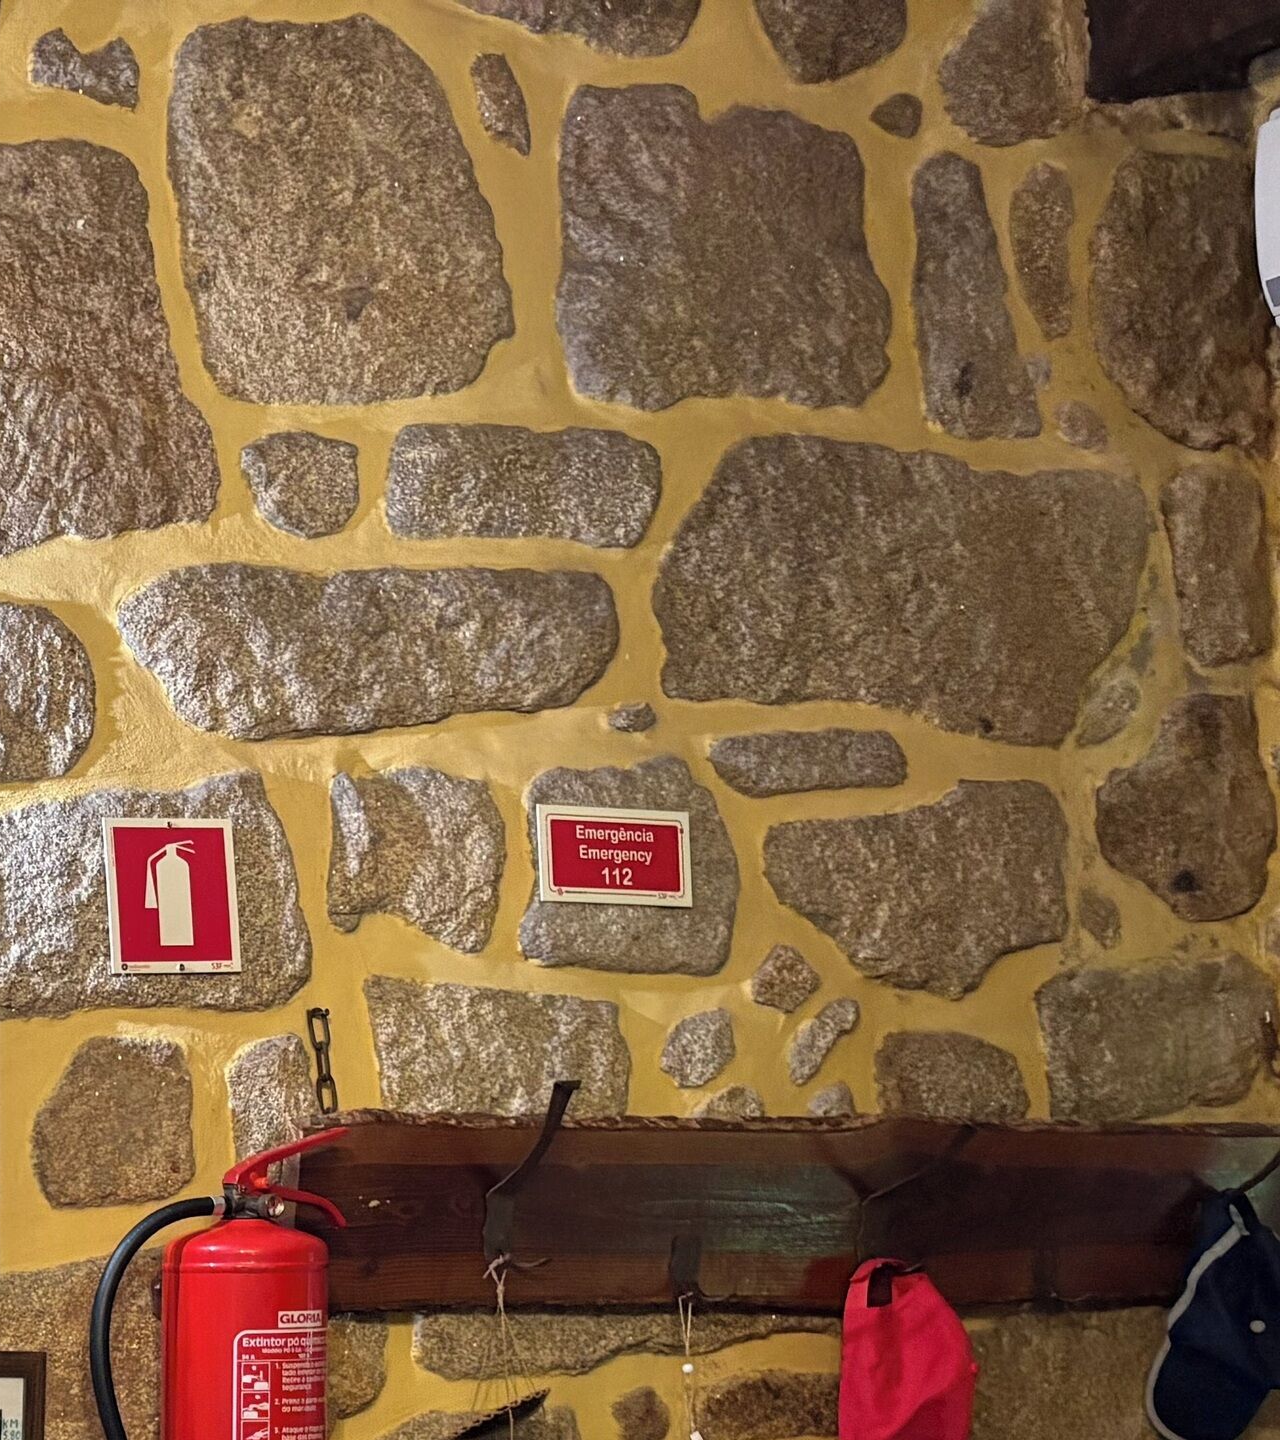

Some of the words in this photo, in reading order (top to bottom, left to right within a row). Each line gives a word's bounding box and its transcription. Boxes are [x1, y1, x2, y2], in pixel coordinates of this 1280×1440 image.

[576, 825, 654, 844] Emergência
[579, 844, 653, 865] Emergency
[601, 867, 633, 886] 112
[280, 1313, 320, 1324] GLORIA
[242, 1337, 285, 1347] Extintor
[2, 1419, 19, 1429] KM
